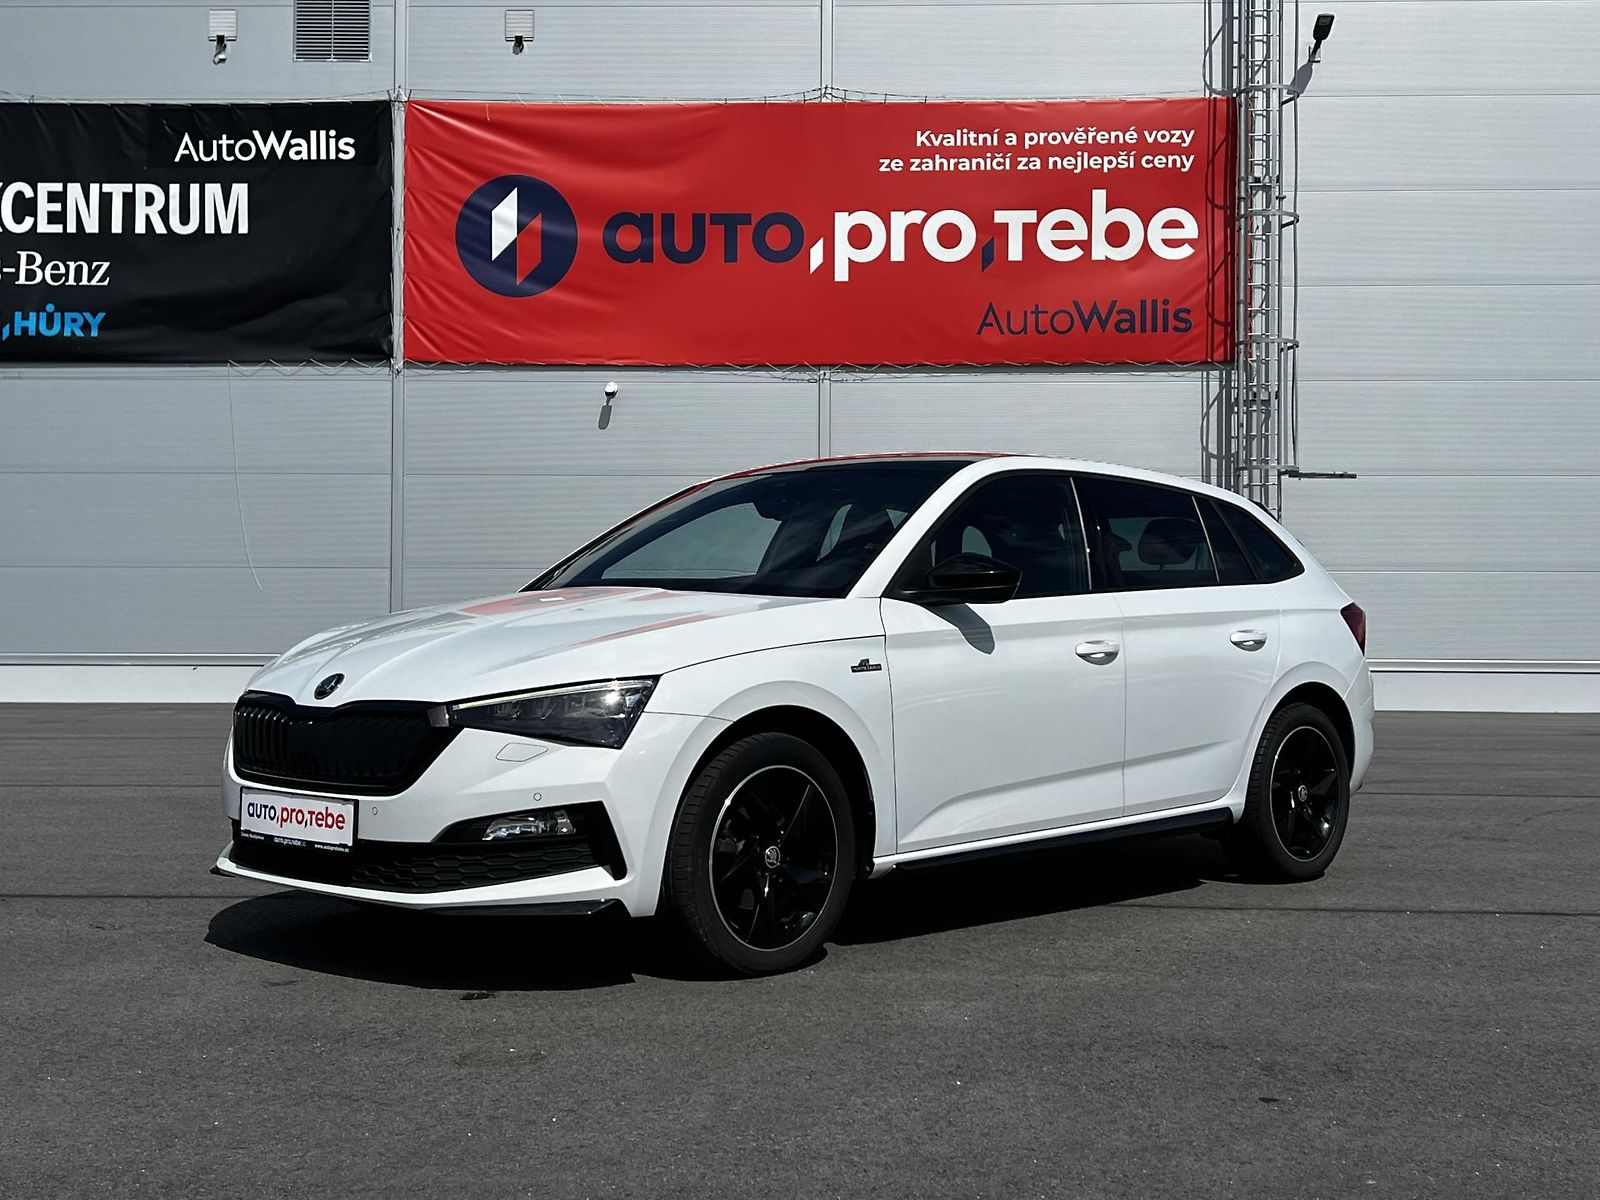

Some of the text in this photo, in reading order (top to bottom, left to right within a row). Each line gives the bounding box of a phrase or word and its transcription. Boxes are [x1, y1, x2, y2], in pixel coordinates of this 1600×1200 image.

[174, 129, 356, 163] AutoWallis
[915, 126, 1195, 149] Kvalitní a prověřené vozy
[878, 151, 1195, 174] ze zahraničí za nejlepší ceny
[0, 181, 249, 235] CENTRUM
[0, 250, 111, 286] -Benz
[976, 299, 1193, 336] AutoWallis
